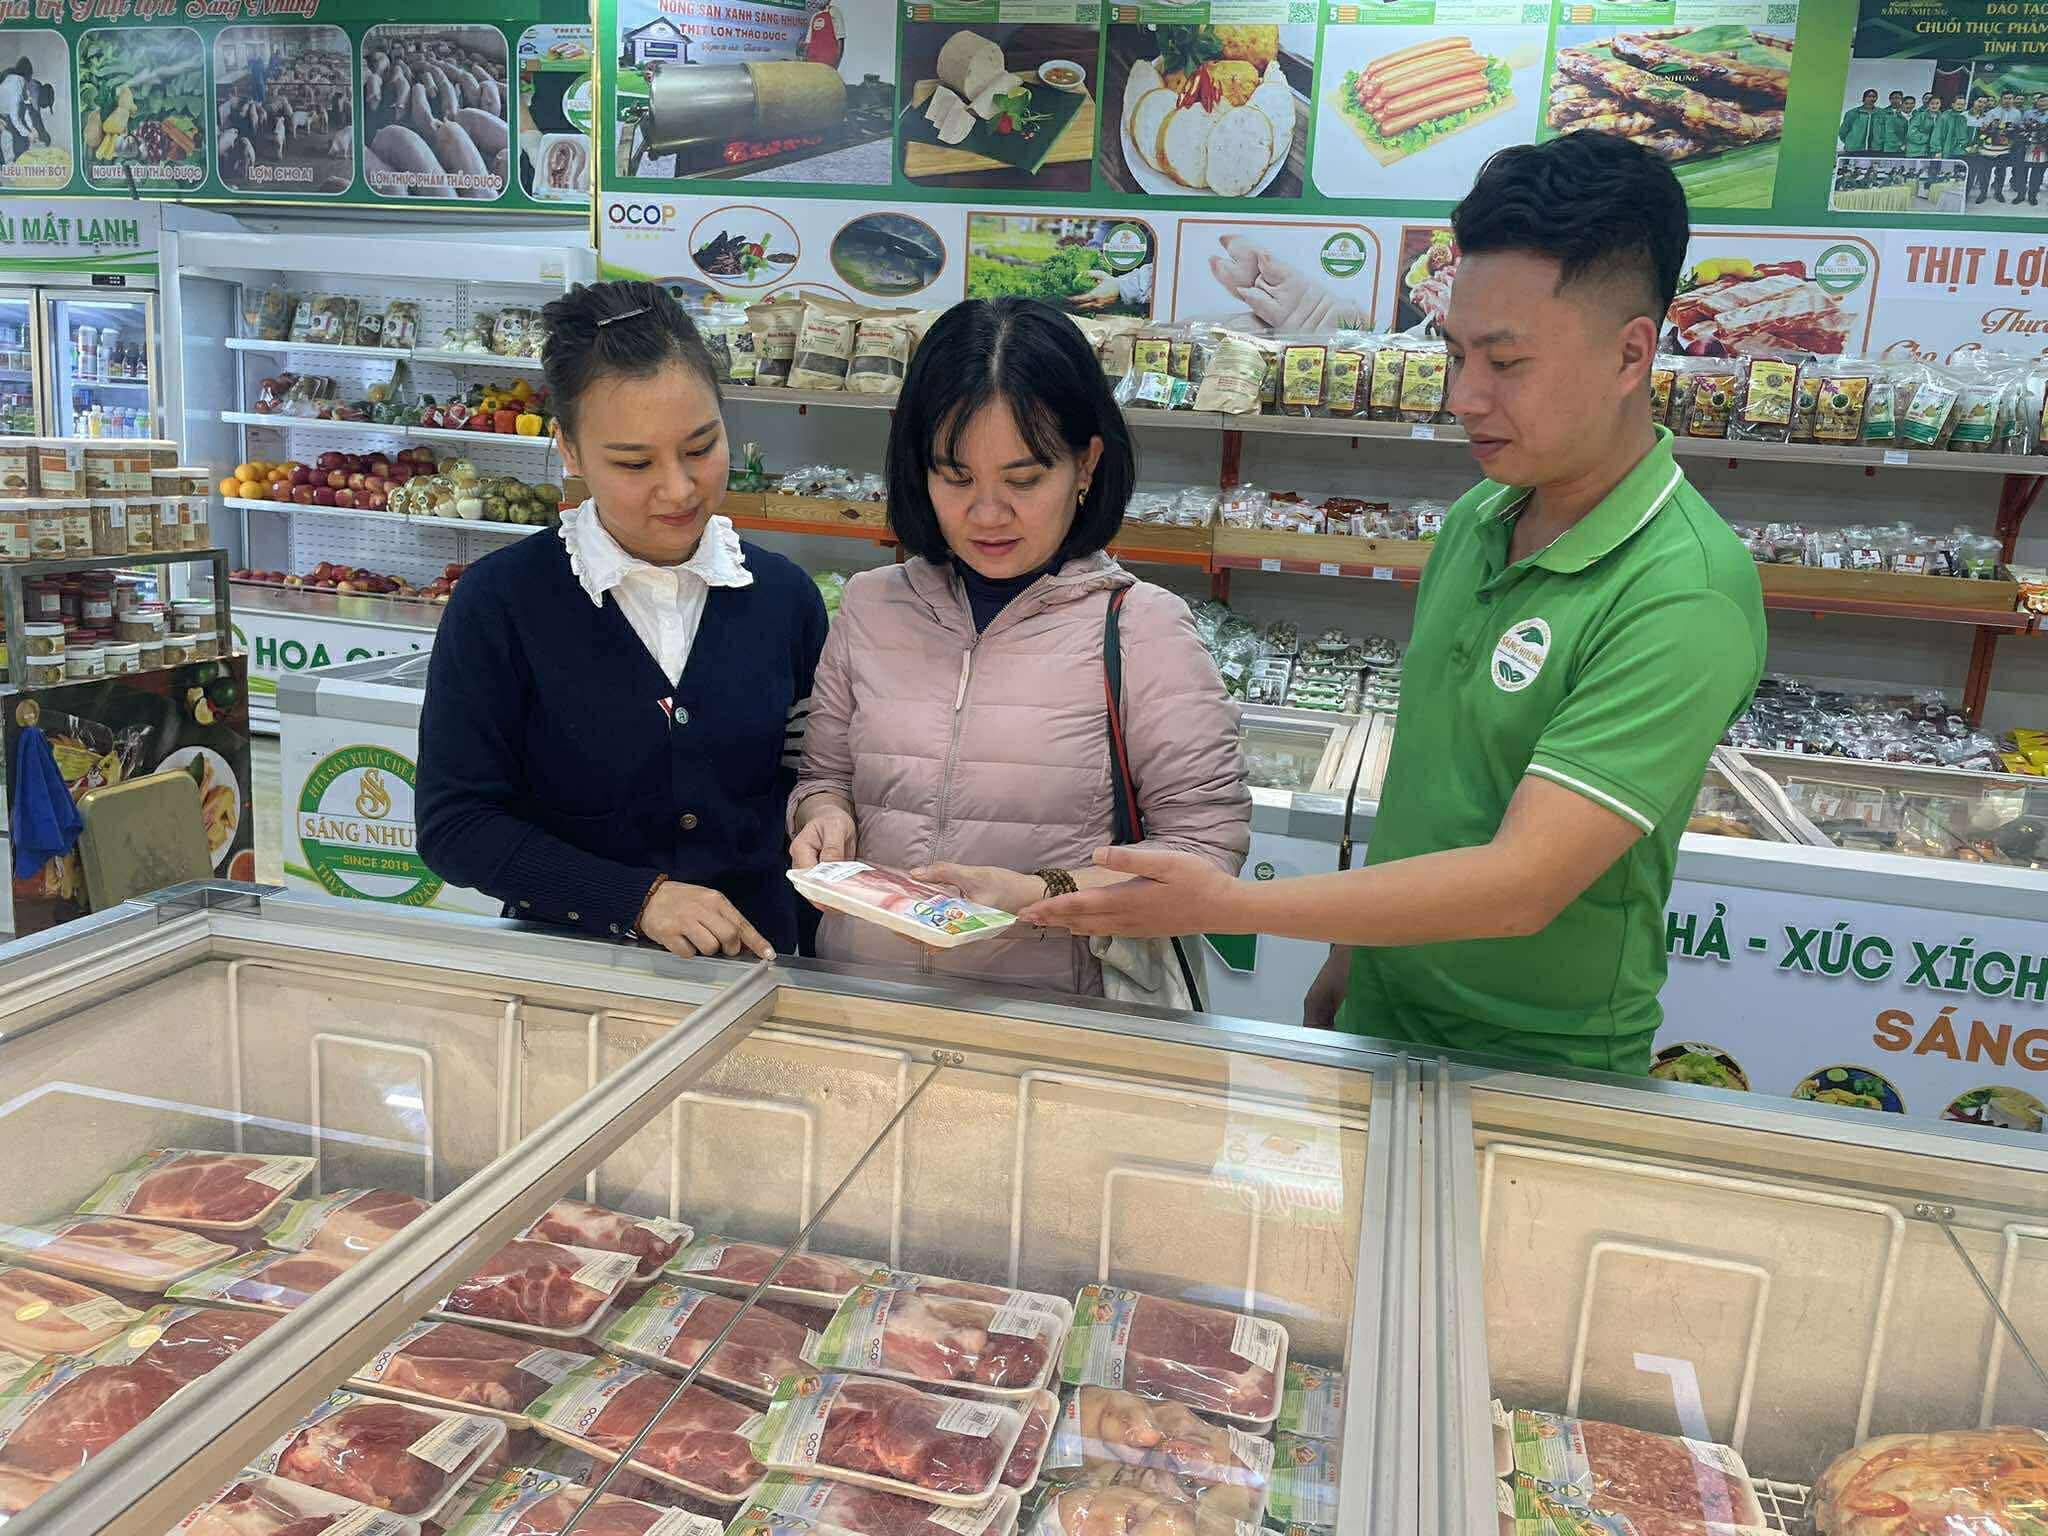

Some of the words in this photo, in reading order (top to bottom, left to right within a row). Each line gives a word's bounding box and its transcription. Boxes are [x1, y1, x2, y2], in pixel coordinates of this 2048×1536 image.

[608, 203, 676, 225] OCOP
[1906, 246, 1986, 292] THỊT
[255, 635, 332, 670] HOA
[304, 817, 361, 843] SÁNG
[1779, 921, 1895, 982] XÚC
[1905, 936, 2048, 1001] XÍCH
